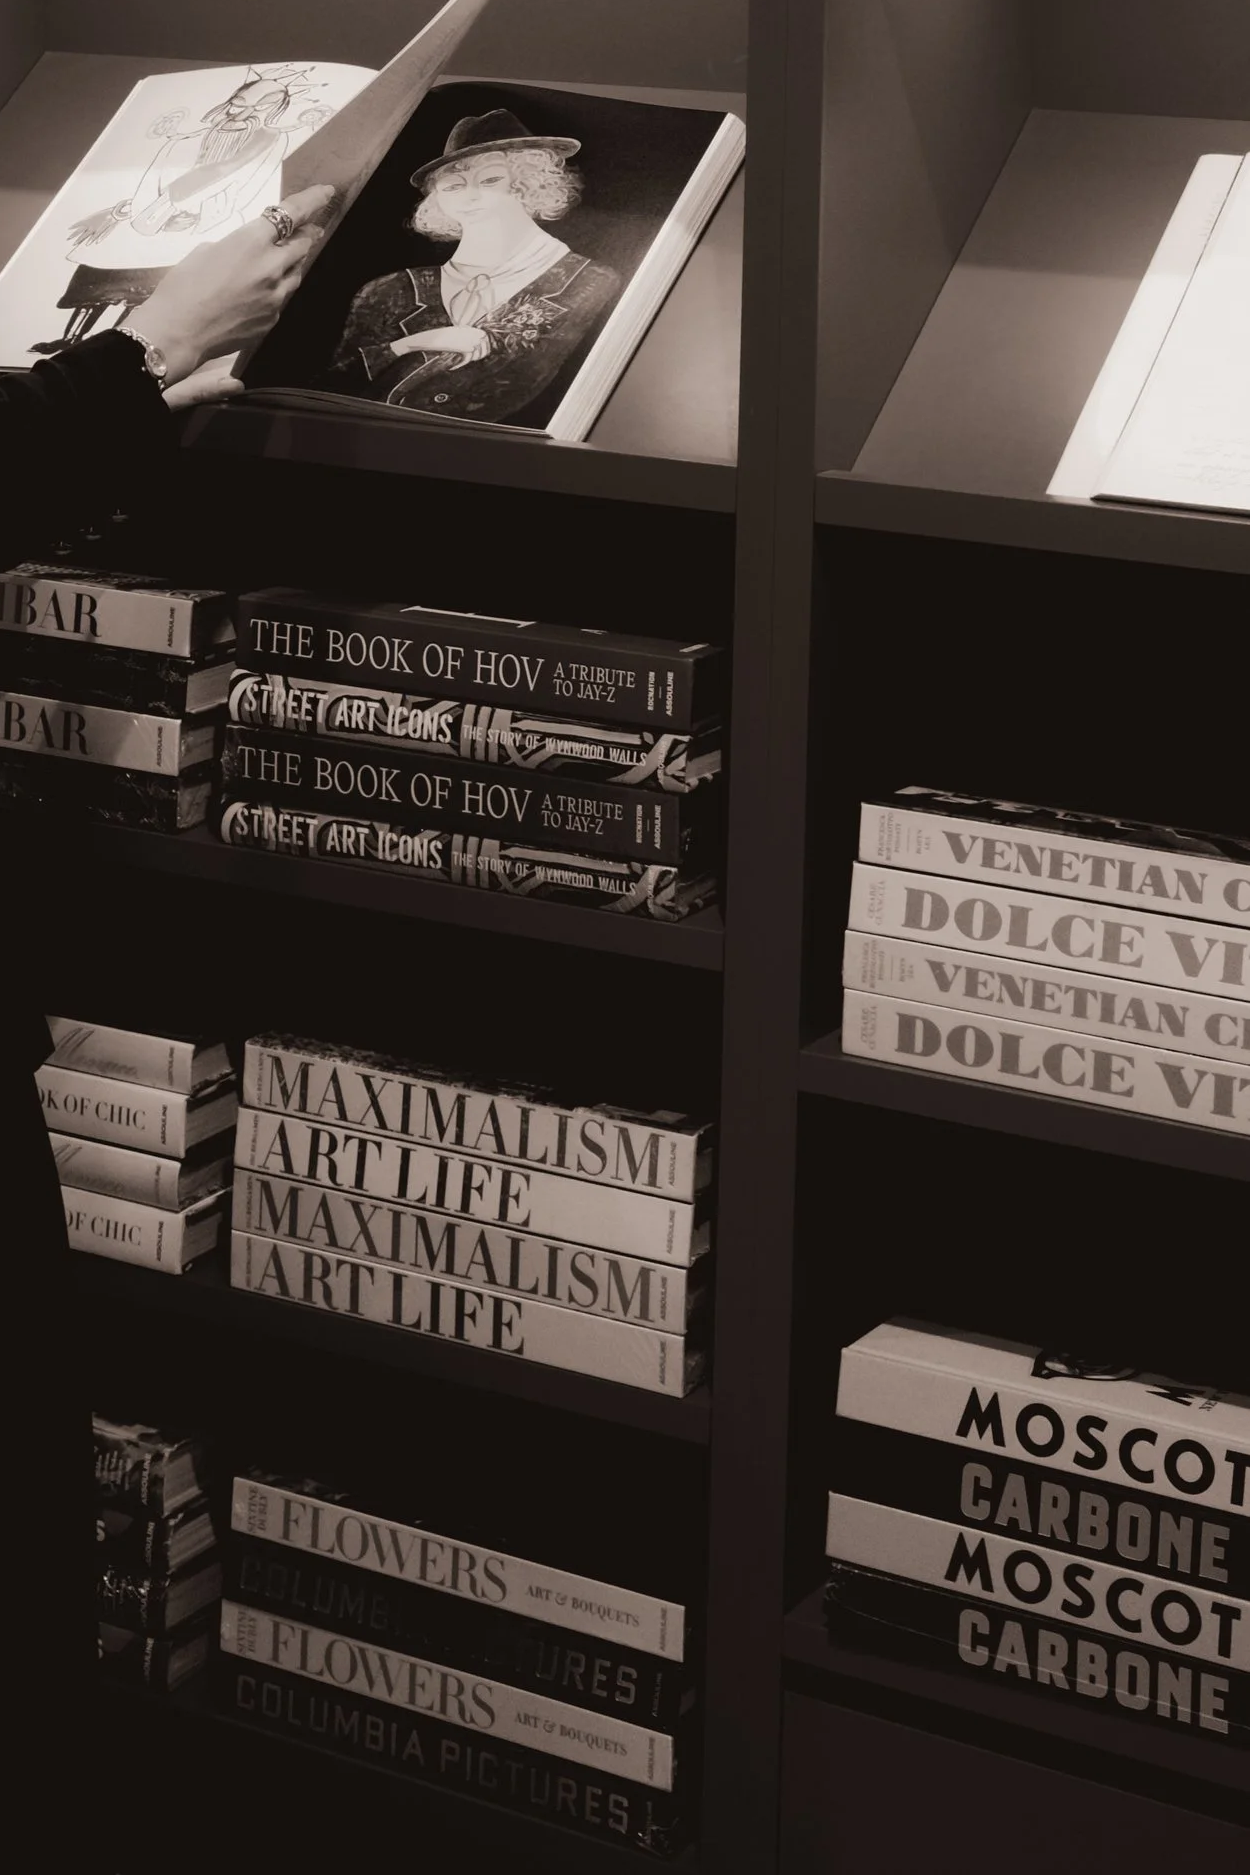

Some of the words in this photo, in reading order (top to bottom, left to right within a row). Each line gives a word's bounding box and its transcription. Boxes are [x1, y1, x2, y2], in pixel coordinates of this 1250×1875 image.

[250, 618, 315, 660] THE
[325, 628, 413, 674] BOOK
[421, 642, 465, 683] OF
[472, 648, 545, 692] HOV
[552, 678, 574, 696] TO
[577, 681, 617, 704] JAY-Z
[553, 662, 566, 678] A
[568, 663, 637, 689] TRIBUTE
[244, 682, 330, 725] STREET
[334, 694, 383, 733] ART
[385, 704, 454, 744] ICONS
[665, 671, 675, 716] ASSOULINE
[462, 724, 483, 741] THE
[486, 728, 523, 748] STORY
[525, 733, 540, 749] OF
[545, 736, 605, 761] WYNWOOD
[609, 746, 648, 767] WALLS
[237, 745, 303, 788] THE
[313, 756, 402, 805] BOOK
[410, 772, 452, 810] OF
[461, 779, 534, 823] HOV
[541, 809, 561, 827] TO
[565, 812, 605, 835] JAY-Z
[654, 804, 662, 850] ASSOULINE
[451, 851, 472, 868] THE
[477, 855, 512, 876] STORY
[514, 861, 530, 877] OF
[534, 865, 594, 889] WYNWOOD
[598, 874, 636, 896] WALLS
[941, 830, 1208, 905] VENETIAN
[901, 886, 1145, 969] DOLCE
[1165, 929, 1250, 987] VI
[63, 1093, 92, 1116] OF
[94, 1101, 147, 1130] CHIC
[264, 1053, 667, 1189] MAXIMALISM
[258, 1120, 382, 1192] ART
[395, 1145, 533, 1228] LIFE
[253, 1177, 656, 1324] MAXIMALISM
[253, 1242, 375, 1319] ART
[387, 1272, 525, 1356] LIFE
[955, 1386, 1250, 1507] MOSCOT
[279, 1495, 508, 1605] FLOWERS
[960, 1462, 1230, 1584] CARBONE
[525, 1584, 551, 1601] ART
[554, 1591, 569, 1607] &
[571, 1597, 641, 1629] BOUQUETS
[268, 1618, 498, 1729] FLOWERS
[958, 1608, 1230, 1735] CARBONE
[235, 1673, 427, 1768] COLUMBIA
[439, 1737, 630, 1838] PICTURES
[514, 1711, 540, 1728] ART
[542, 1719, 558, 1734] &
[558, 1723, 629, 1757] BOUQUETS
